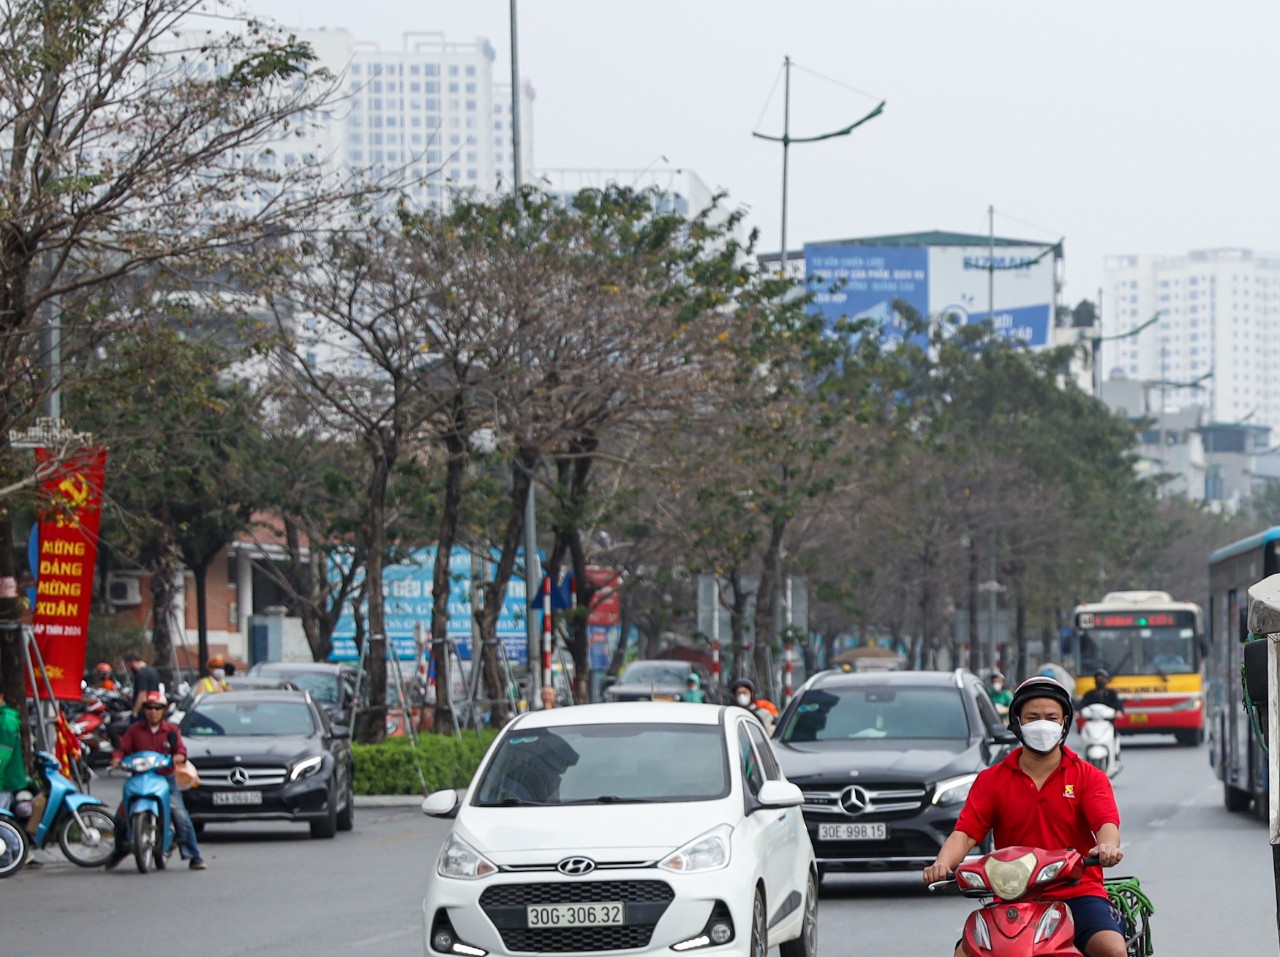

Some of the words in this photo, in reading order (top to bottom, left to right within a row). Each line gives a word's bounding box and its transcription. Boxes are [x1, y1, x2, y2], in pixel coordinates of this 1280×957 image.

[43, 538, 84, 556] MỪNG
[40, 558, 82, 576] ĐẢNG
[38, 579, 81, 597] MỪNG
[37, 600, 78, 617] XUÂN
[821, 825, 884, 838] 30E-998.15
[530, 906, 621, 925] 30G-306.32
